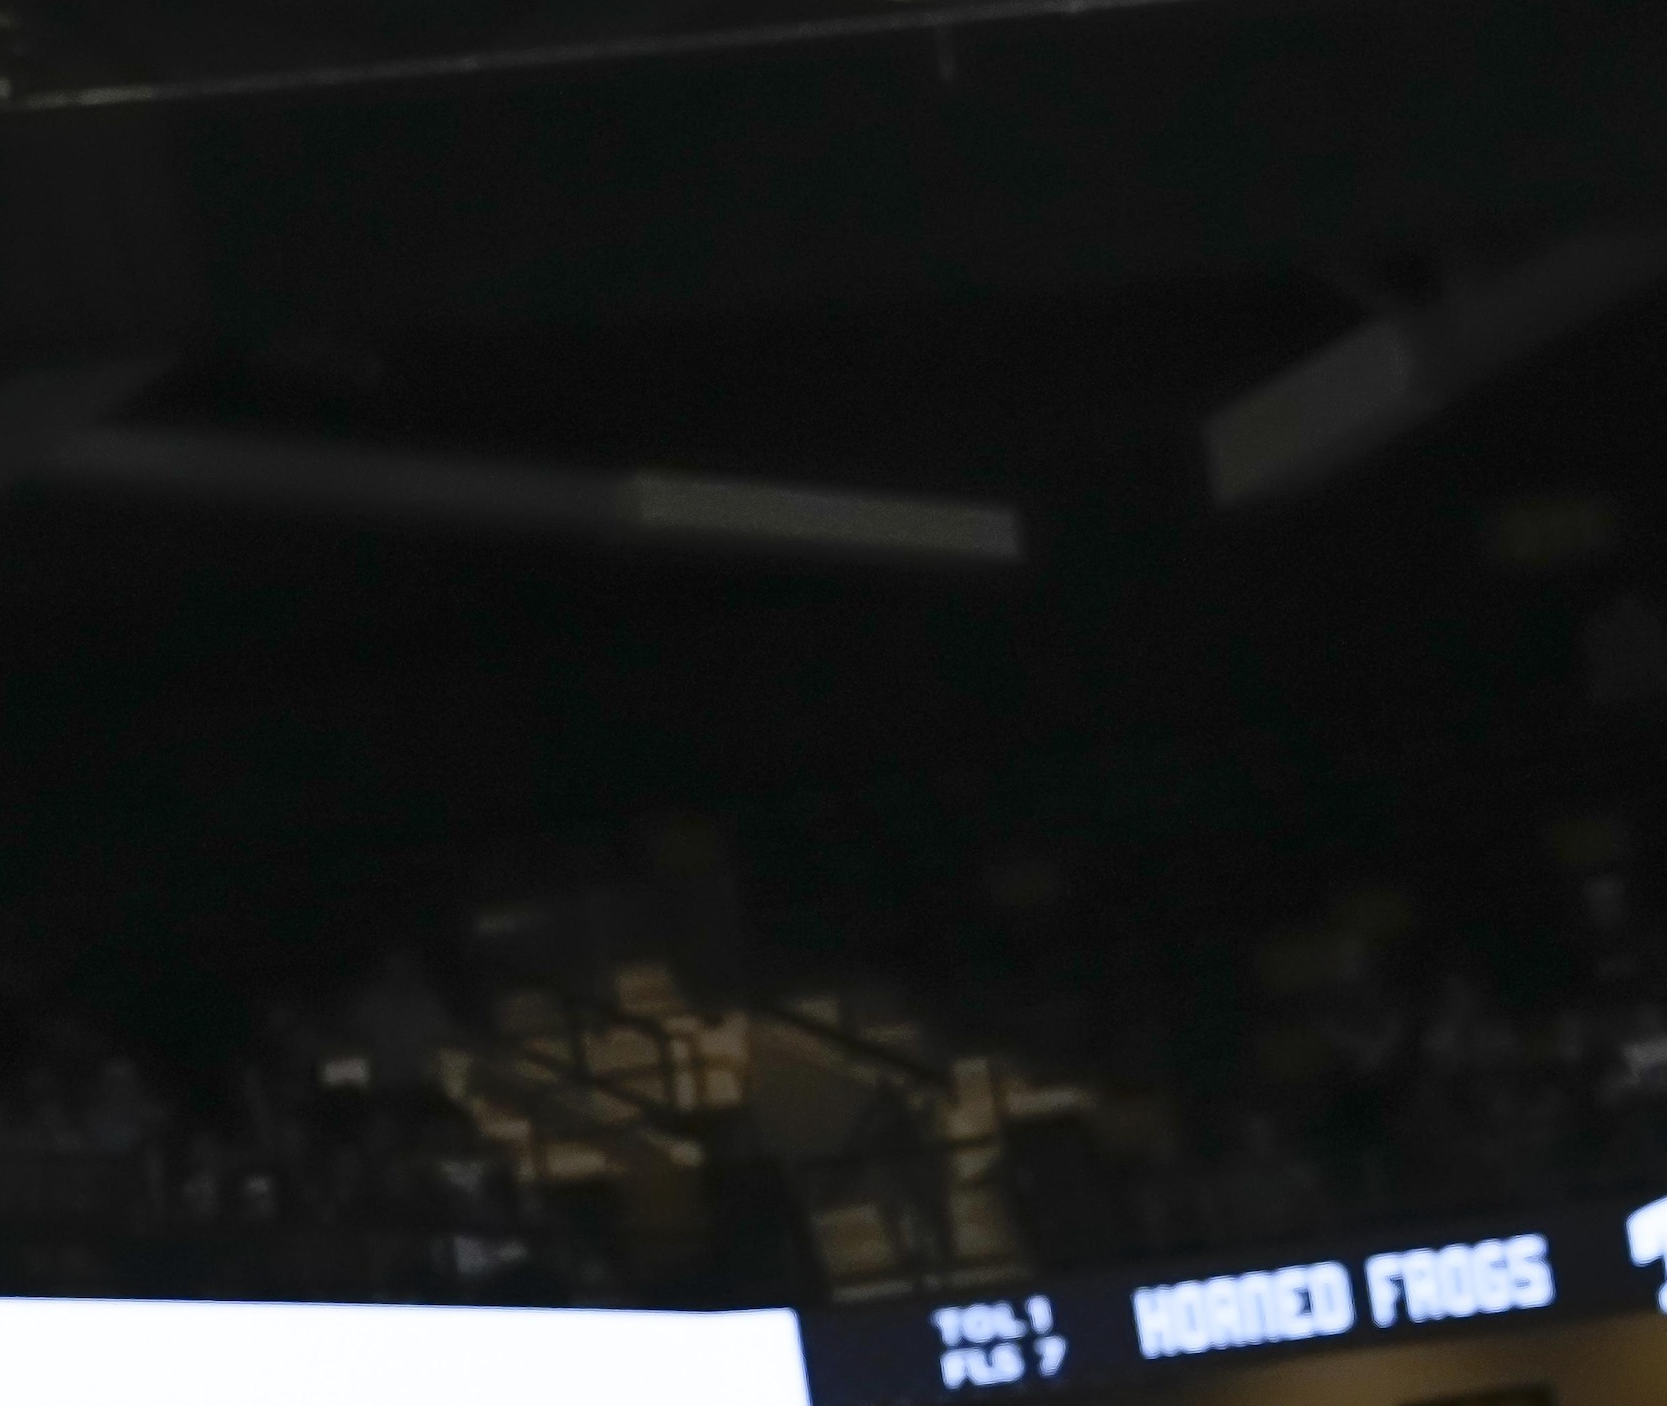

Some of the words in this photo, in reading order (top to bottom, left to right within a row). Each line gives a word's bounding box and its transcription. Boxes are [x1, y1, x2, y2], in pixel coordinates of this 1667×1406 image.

[1132, 1260, 1356, 1360] HORNED
[1364, 1232, 1556, 1329] FROGS
[1033, 1333, 1067, 1379] 7
